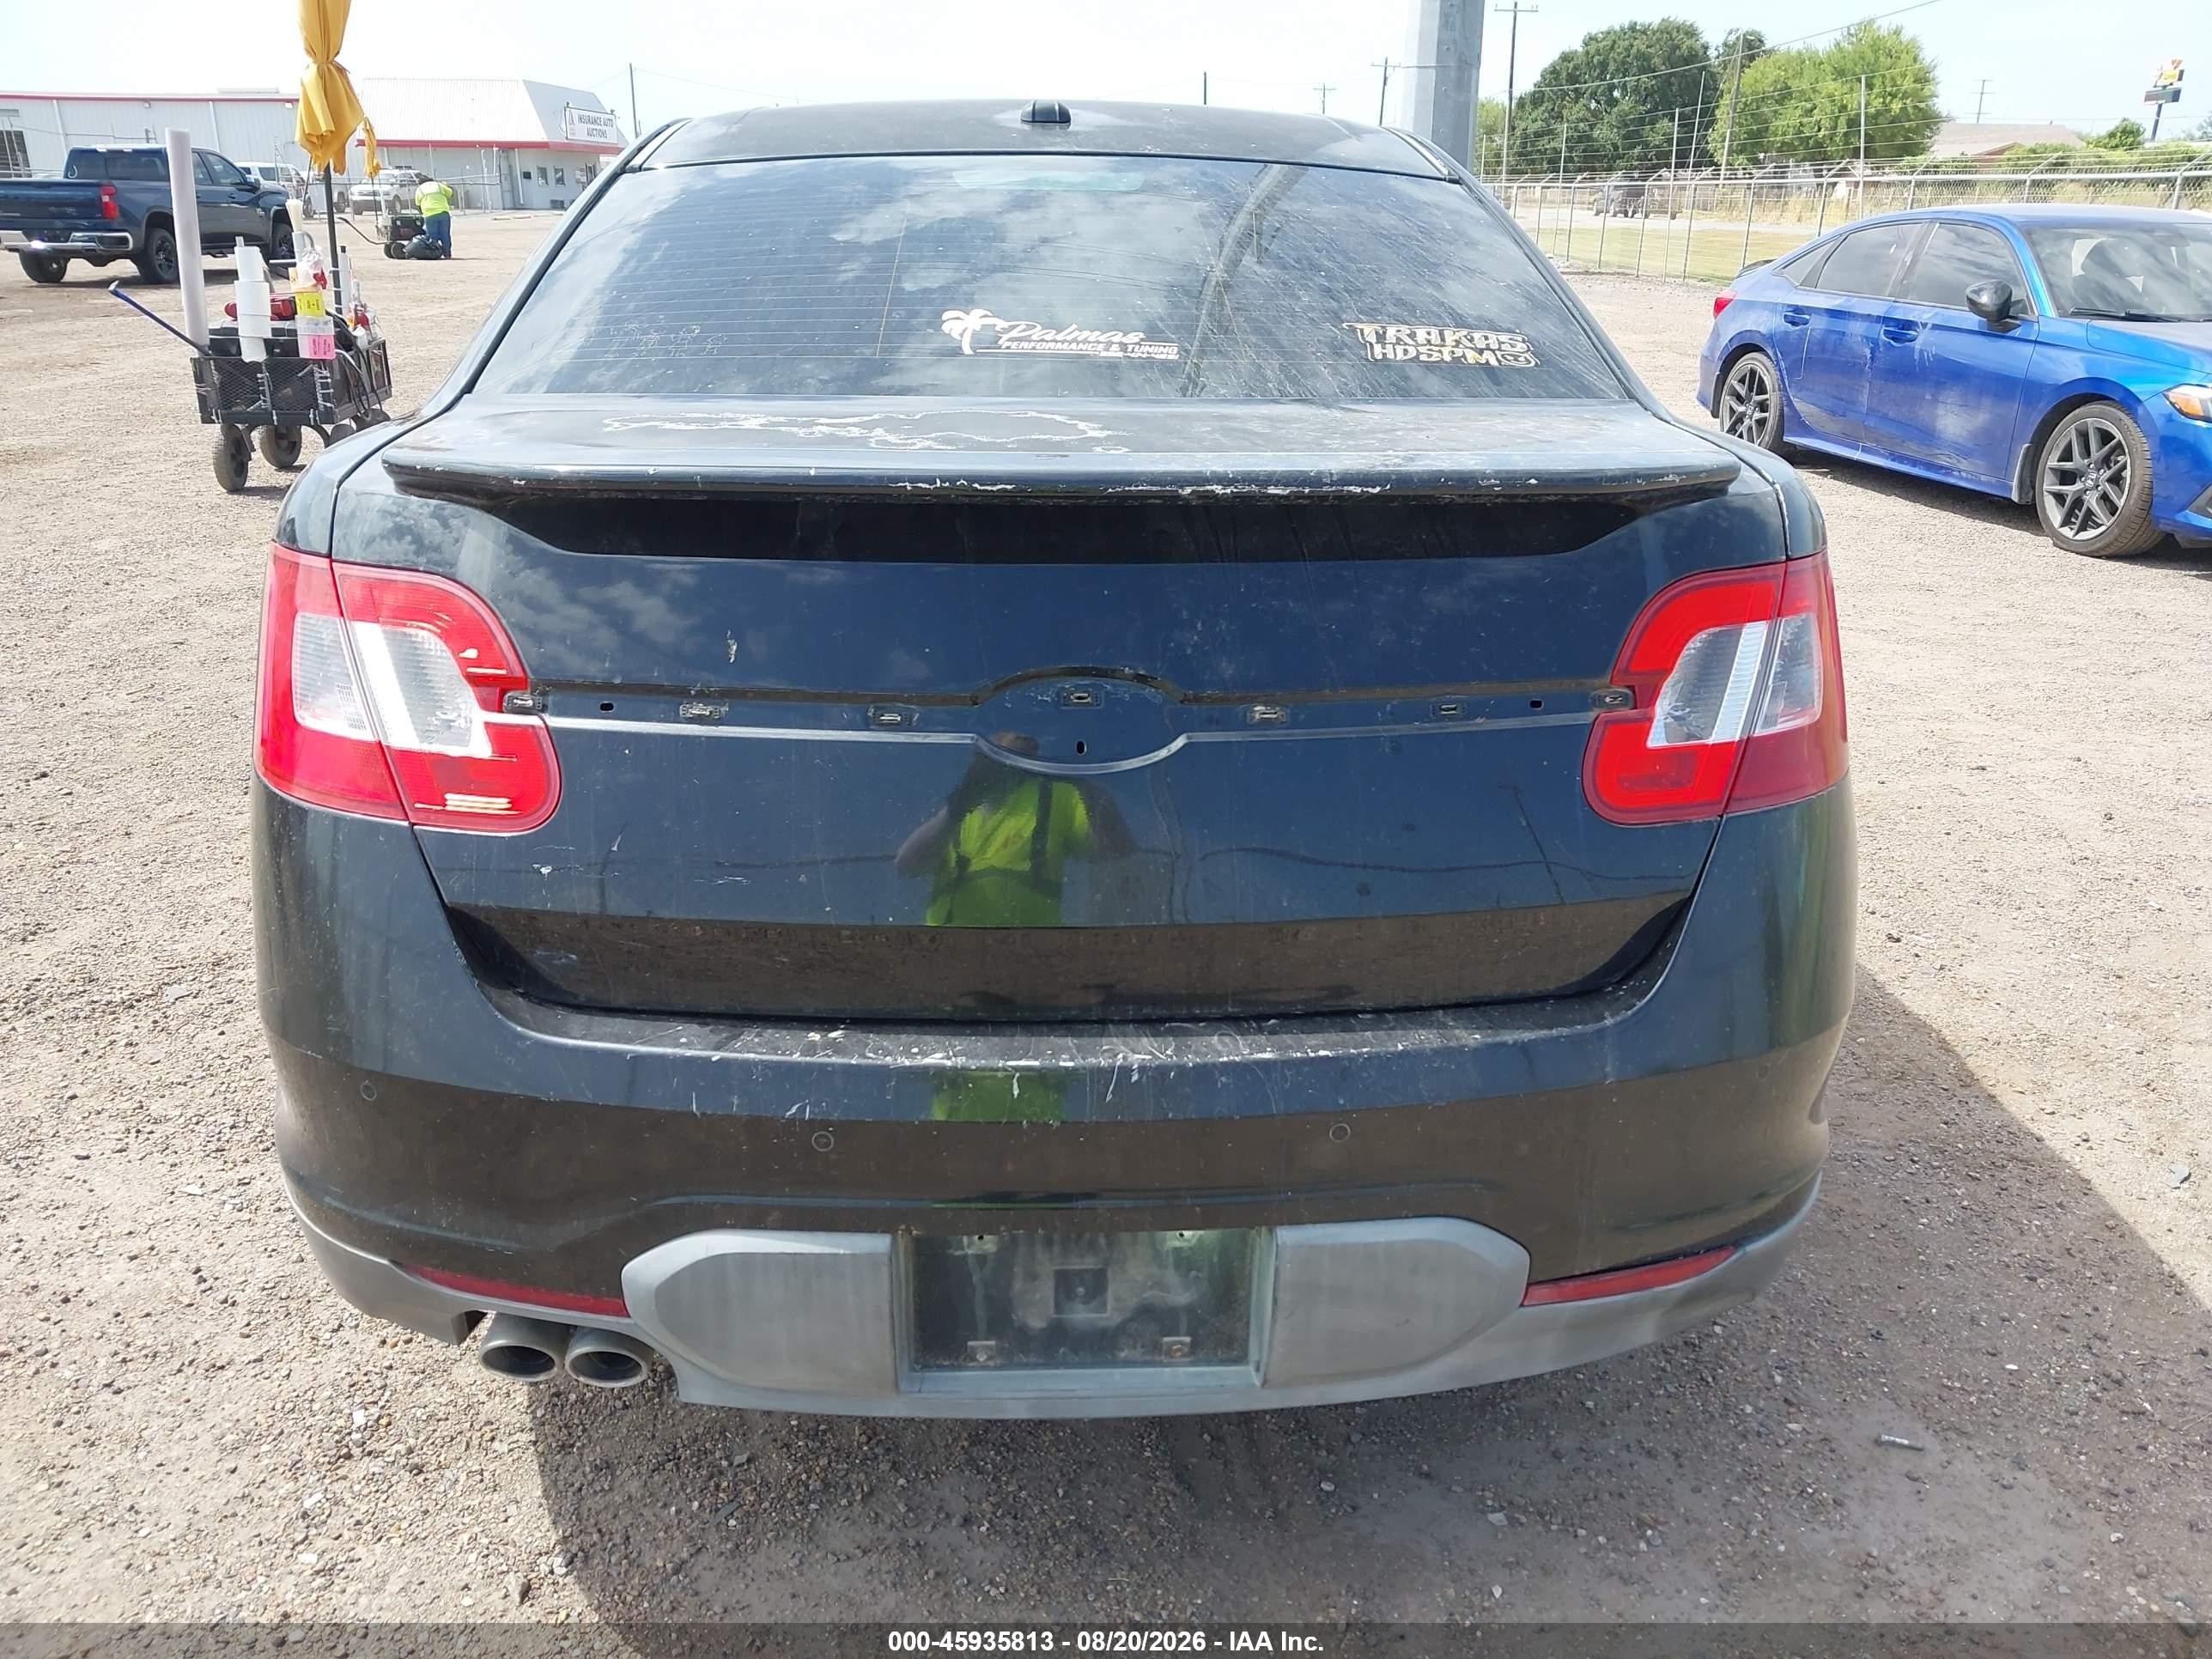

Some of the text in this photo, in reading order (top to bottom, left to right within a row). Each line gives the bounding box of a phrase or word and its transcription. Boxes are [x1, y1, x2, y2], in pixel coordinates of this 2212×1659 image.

[577, 113, 602, 126] INSURANCE
[603, 117, 614, 128] AUTO
[586, 126, 608, 138] AUCTIONS
[997, 321, 1146, 344] Palmas
[1000, 341, 1179, 355] PERFORMANCE & TUNING
